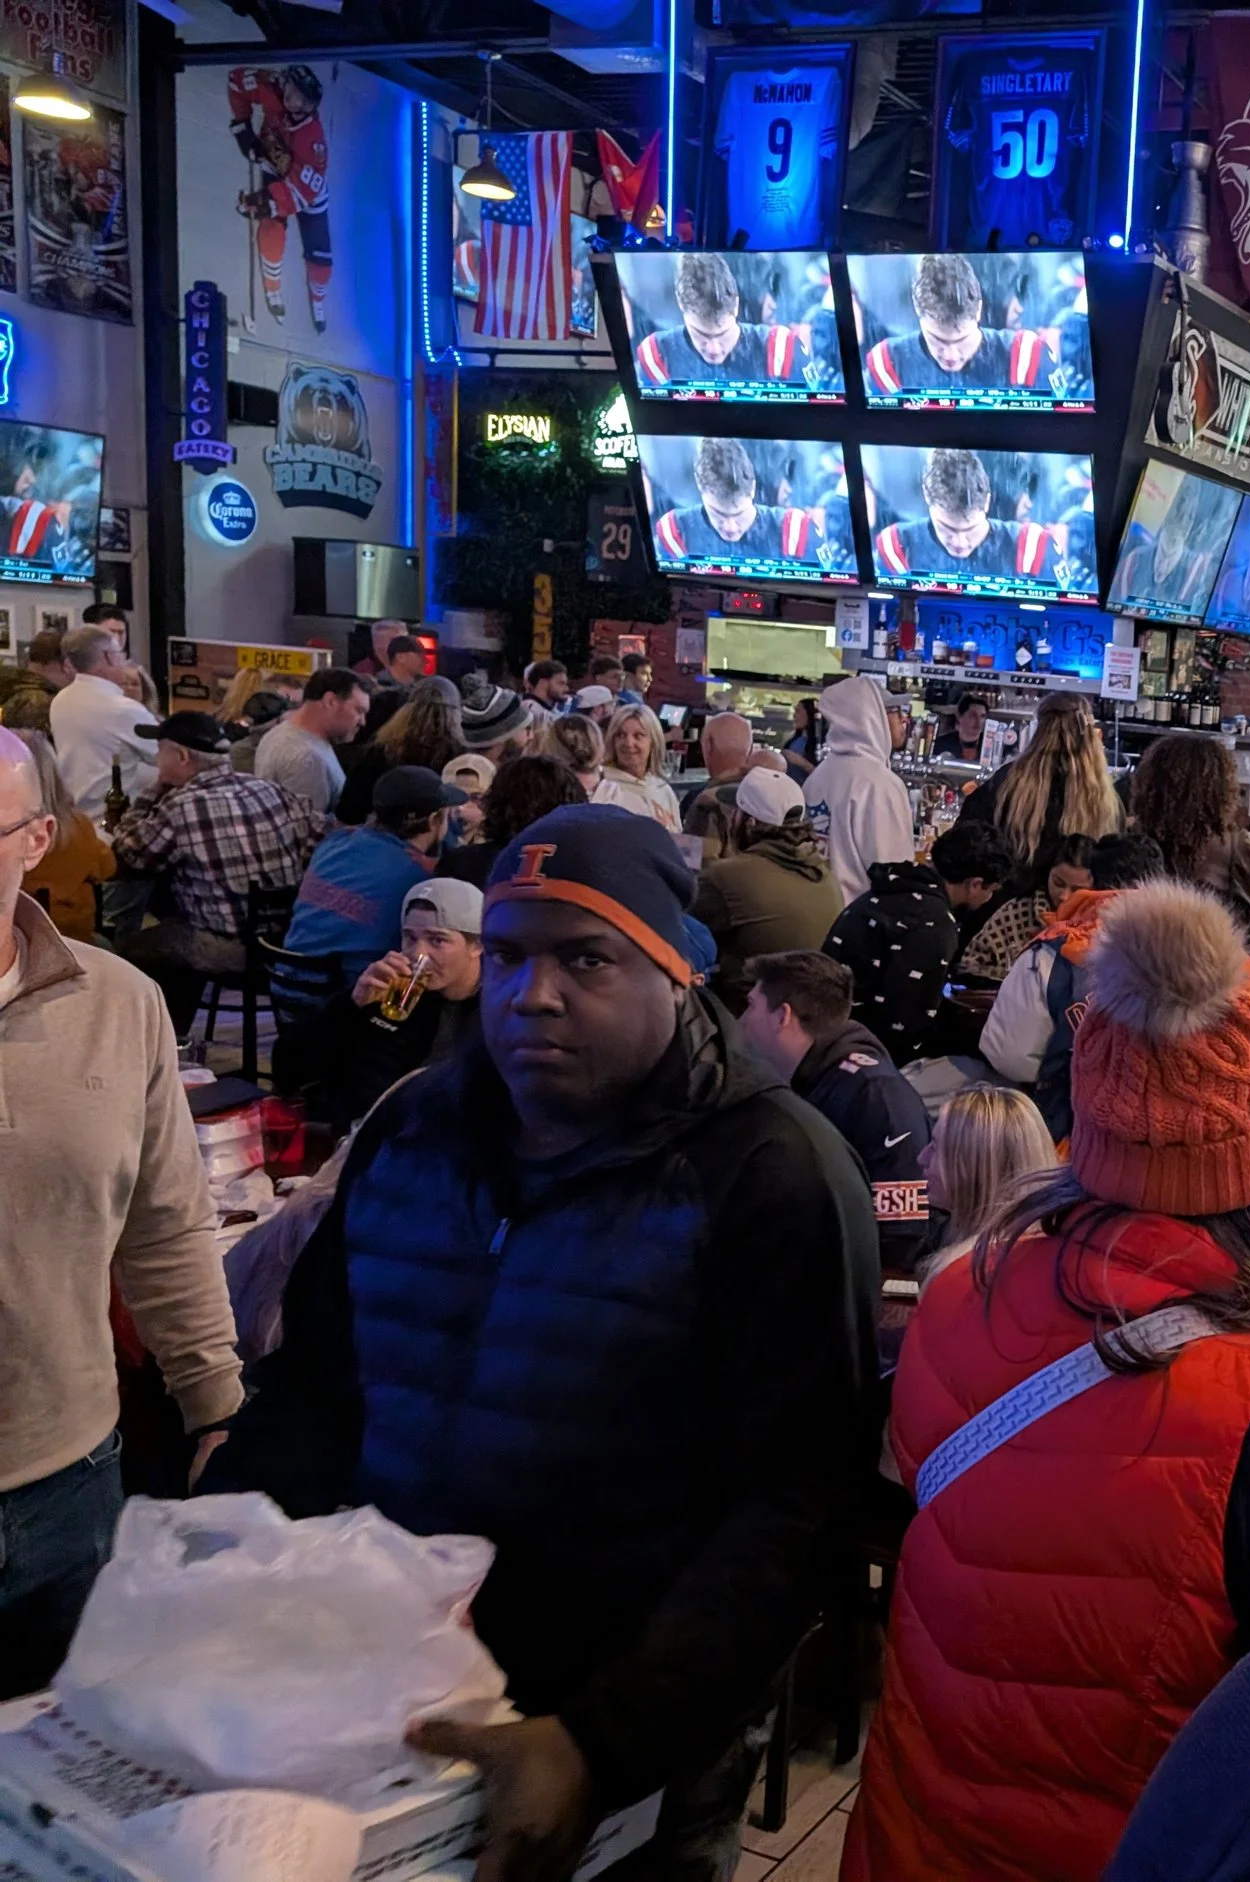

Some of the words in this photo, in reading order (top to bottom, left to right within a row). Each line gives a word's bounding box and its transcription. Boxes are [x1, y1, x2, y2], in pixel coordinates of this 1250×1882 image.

[980, 71, 1074, 95] SINGLETARY
[766, 117, 793, 183] 9
[991, 109, 1059, 179] 50
[300, 164, 324, 192] 88
[190, 290, 212, 437] CHICAGO
[487, 413, 551, 443] ELYSIAN
[275, 463, 377, 500] BEARS
[209, 502, 253, 519] Corona
[602, 522, 632, 560] 29
[255, 651, 290, 669] GRACE
[510, 843, 558, 889] I
[876, 1187, 918, 1213] GSH
